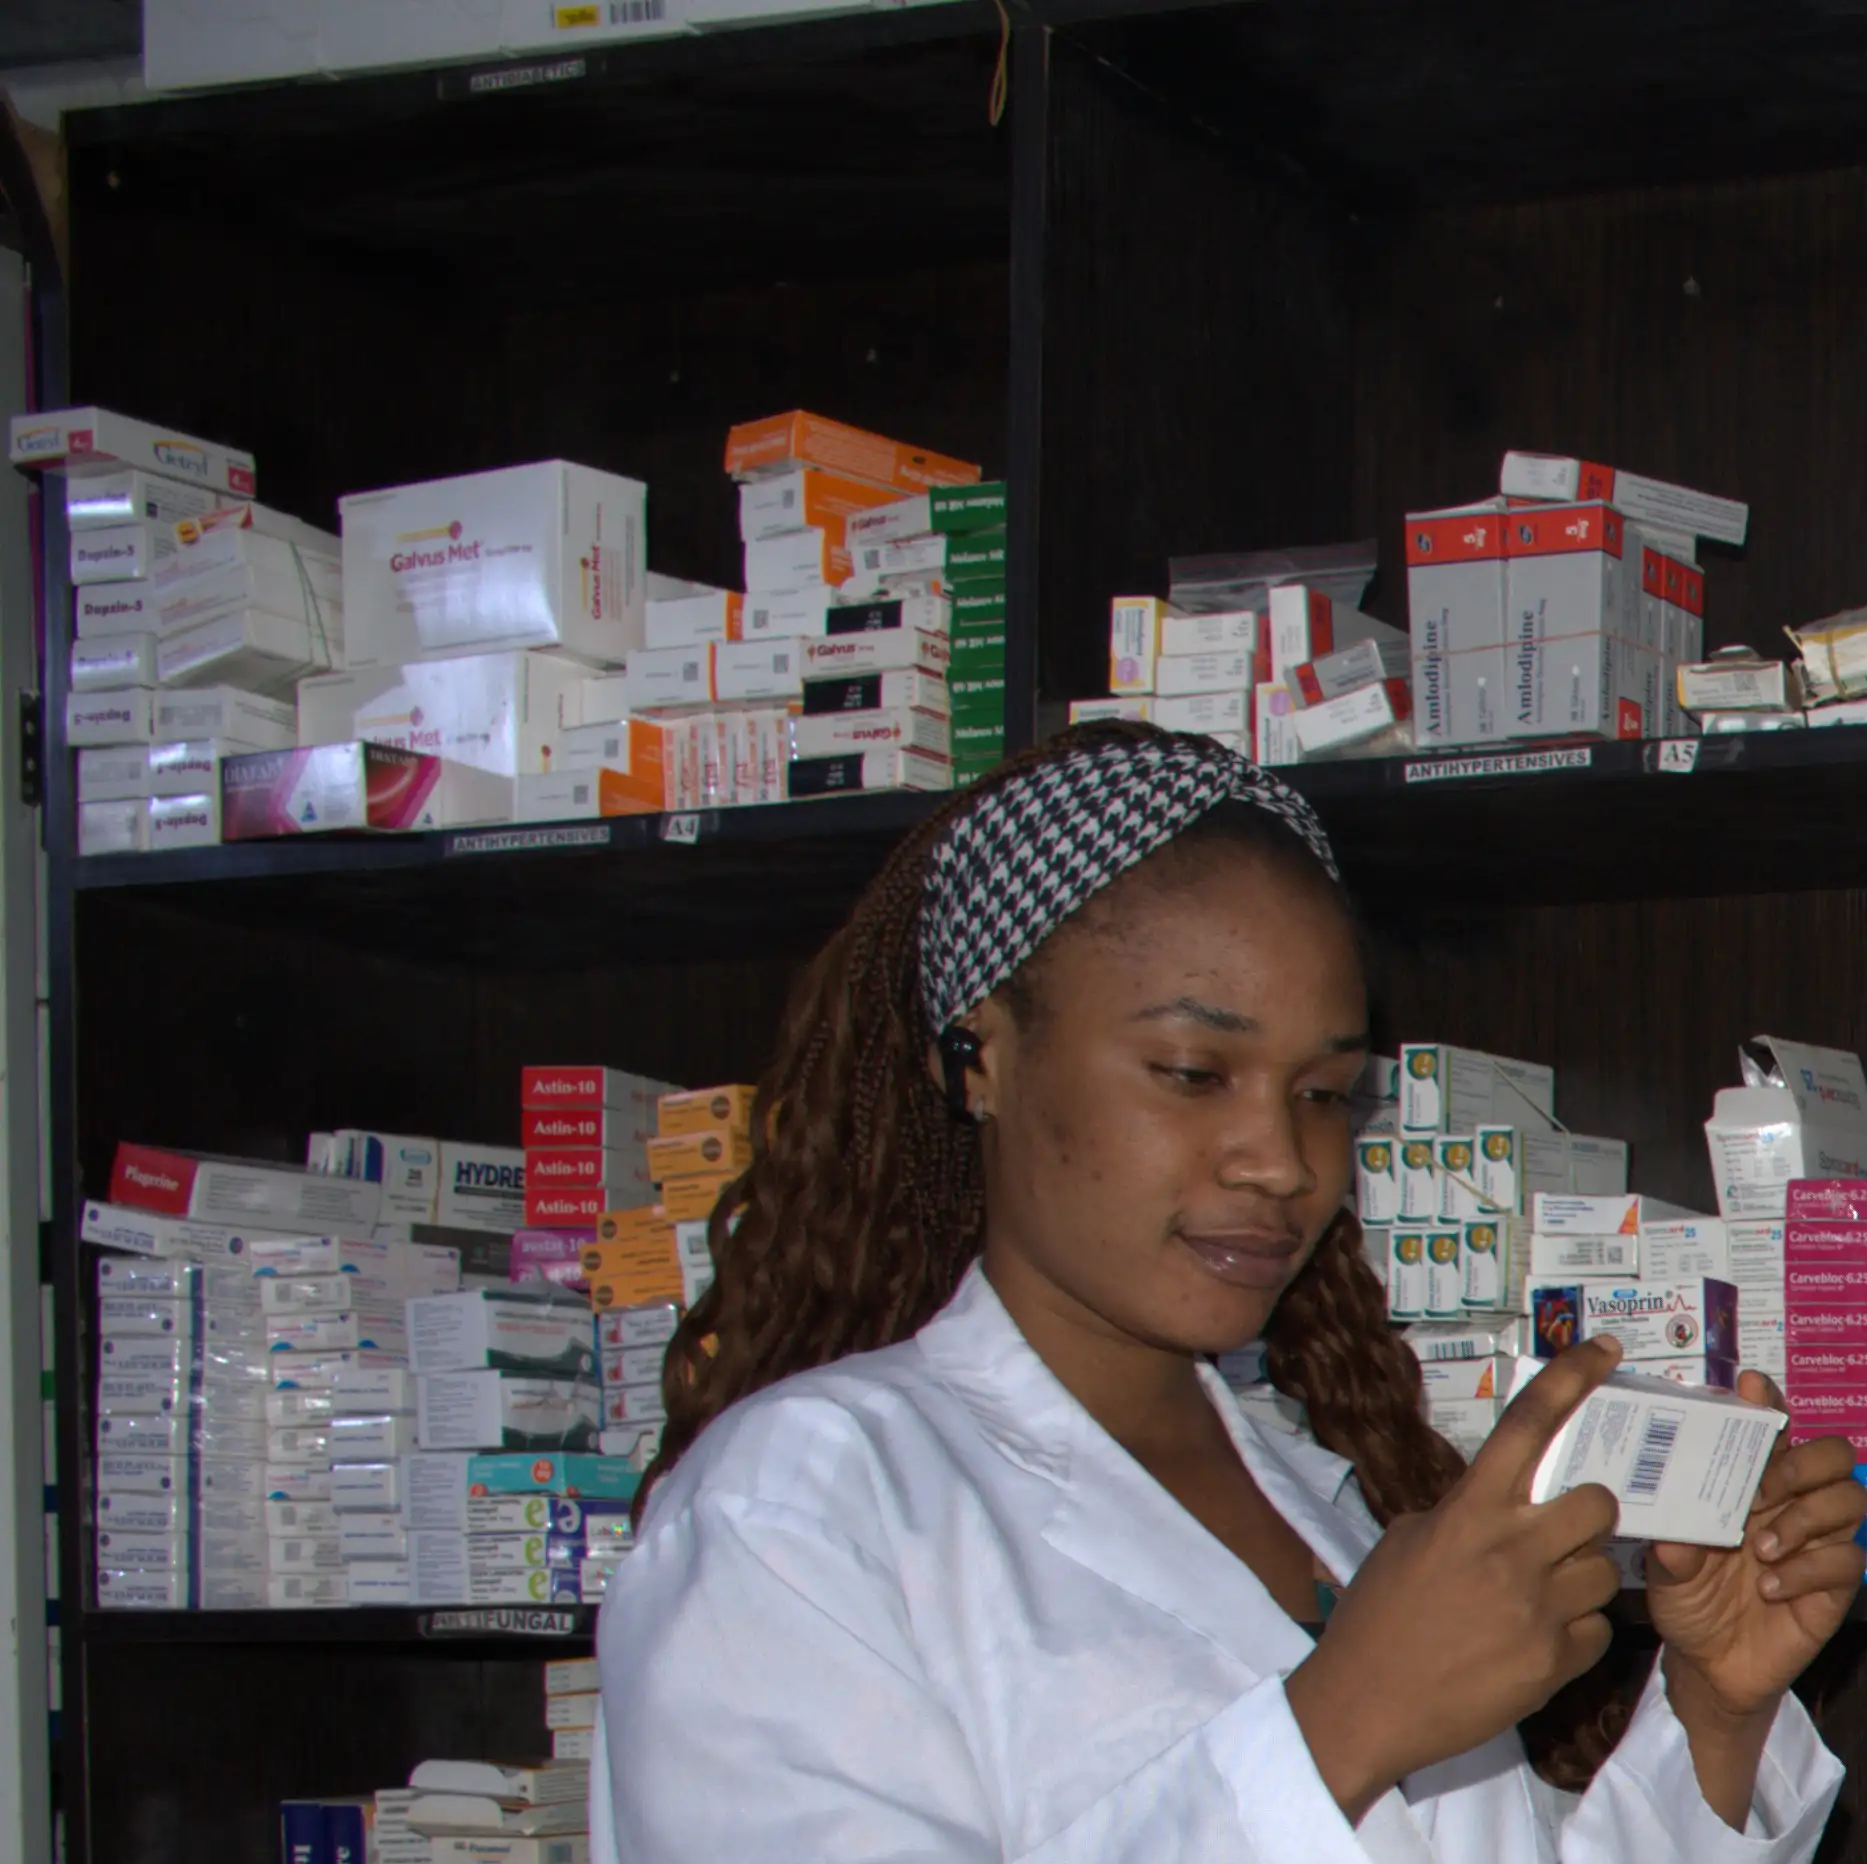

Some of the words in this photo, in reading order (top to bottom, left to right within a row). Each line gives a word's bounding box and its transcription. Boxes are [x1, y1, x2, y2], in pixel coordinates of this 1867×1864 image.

[391, 548, 445, 573] Galvus
[447, 542, 480, 563] Met
[1425, 620, 1442, 737] Amlodipine
[1664, 743, 1694, 763] A5
[1408, 751, 1588, 779] ANTIHYPERTENSIVES
[668, 815, 697, 840] A4
[532, 1079, 595, 1095] Astin-10
[532, 1120, 595, 1136] Astin-10
[1587, 1294, 1664, 1314] Vasoprin
